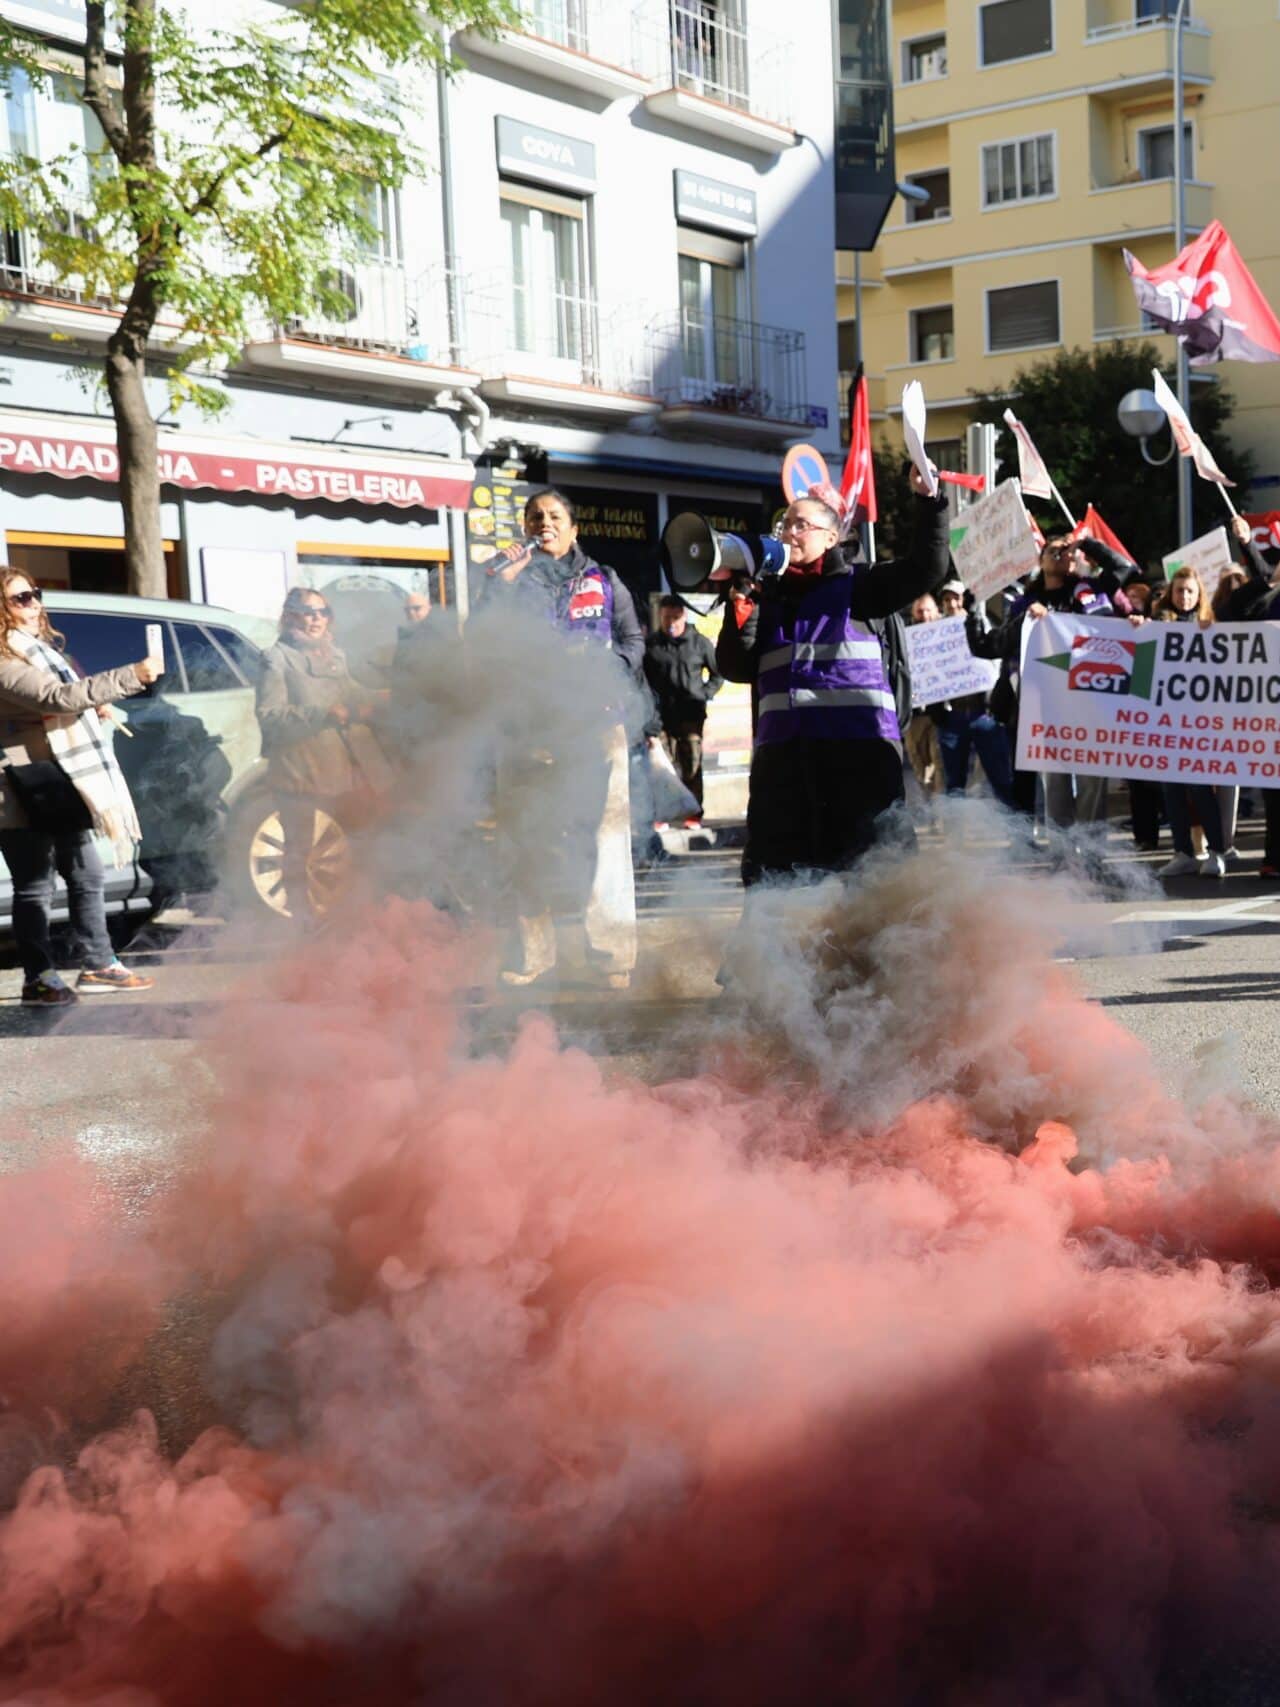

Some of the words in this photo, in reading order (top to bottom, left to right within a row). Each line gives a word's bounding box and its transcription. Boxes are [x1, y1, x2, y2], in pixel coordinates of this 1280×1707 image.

[257, 464, 424, 500] PASTELERIA
[571, 604, 603, 618] CGT
[1163, 632, 1268, 664] BASTA
[1074, 671, 1126, 693] CGT
[1116, 709, 1149, 725] NO
[1157, 711, 1173, 727] A
[1181, 714, 1225, 730] LOS
[1031, 724, 1088, 741] PAGO
[1095, 729, 1266, 754] DIFERENCIADO
[1178, 759, 1238, 775] PARA
